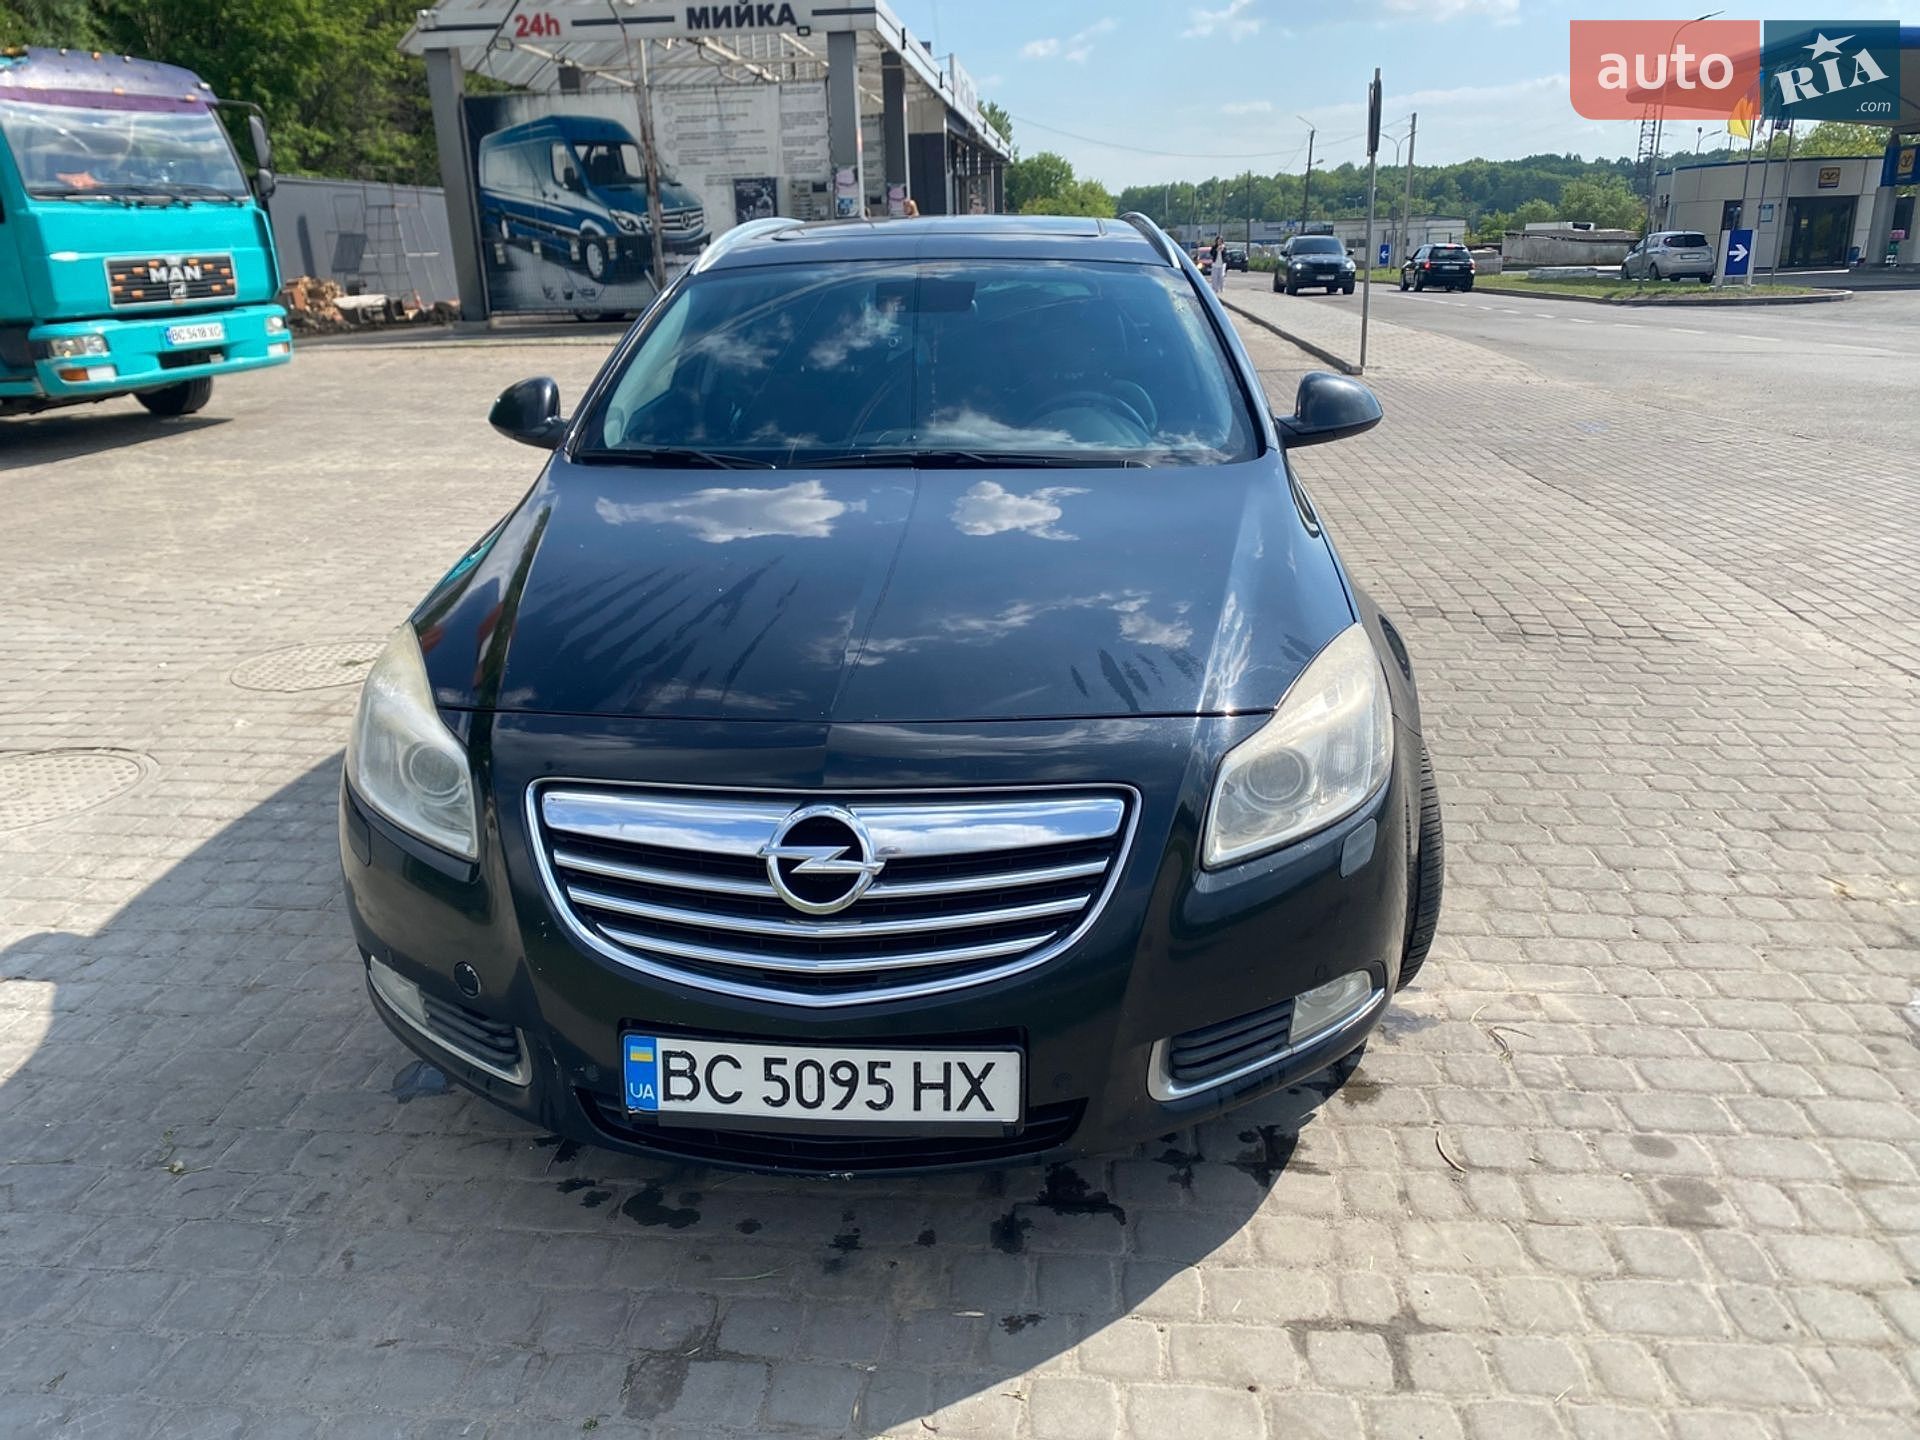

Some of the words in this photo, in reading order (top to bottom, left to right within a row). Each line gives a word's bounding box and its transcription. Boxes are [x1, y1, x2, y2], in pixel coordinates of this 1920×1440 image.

[515, 12, 560, 37] 24h
[686, 0, 797, 30] МИЙКА
[149, 266, 200, 282] MAN
[630, 1081, 655, 1100] UA
[662, 1050, 743, 1104] BC
[762, 1057, 894, 1111] 5095
[913, 1061, 996, 1112] HX
